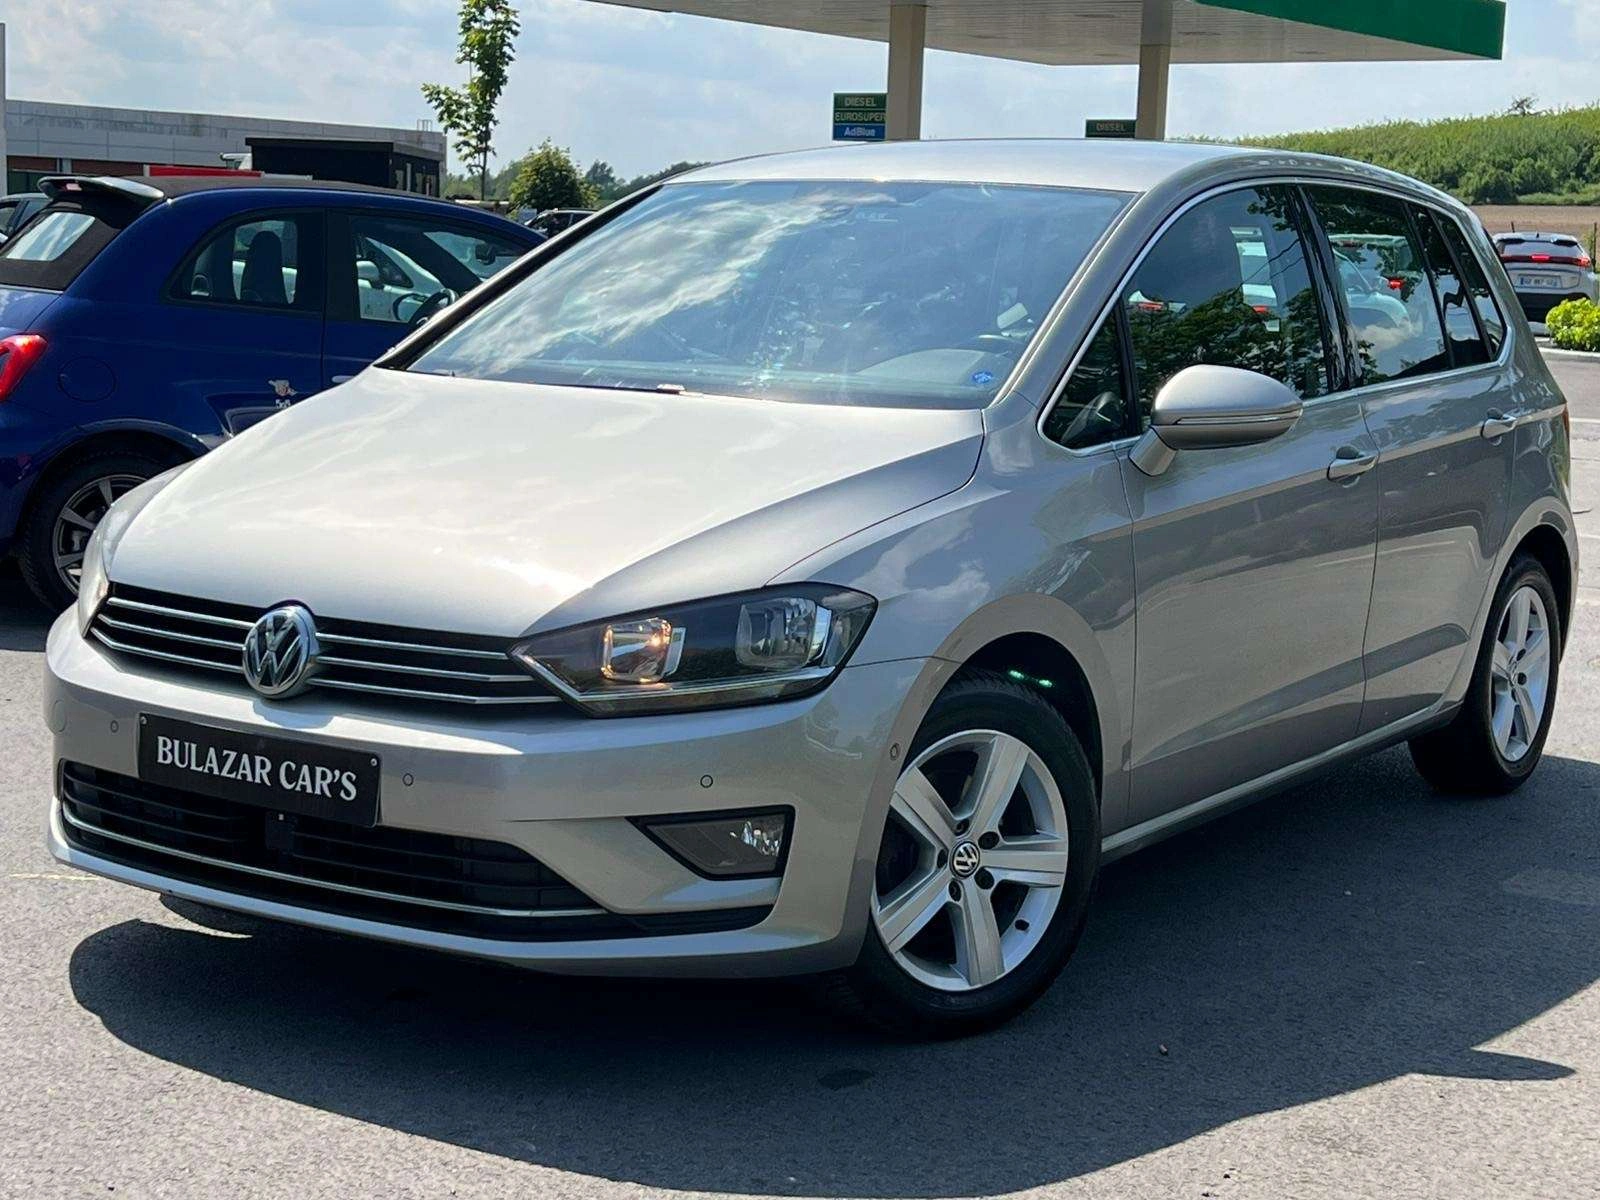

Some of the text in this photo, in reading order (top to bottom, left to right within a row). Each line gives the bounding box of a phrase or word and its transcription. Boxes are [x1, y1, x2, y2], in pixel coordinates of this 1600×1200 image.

[844, 96, 876, 107] DIESEL
[844, 127, 876, 137] AdBlue
[157, 736, 357, 801] BULAZAR CAR'S
